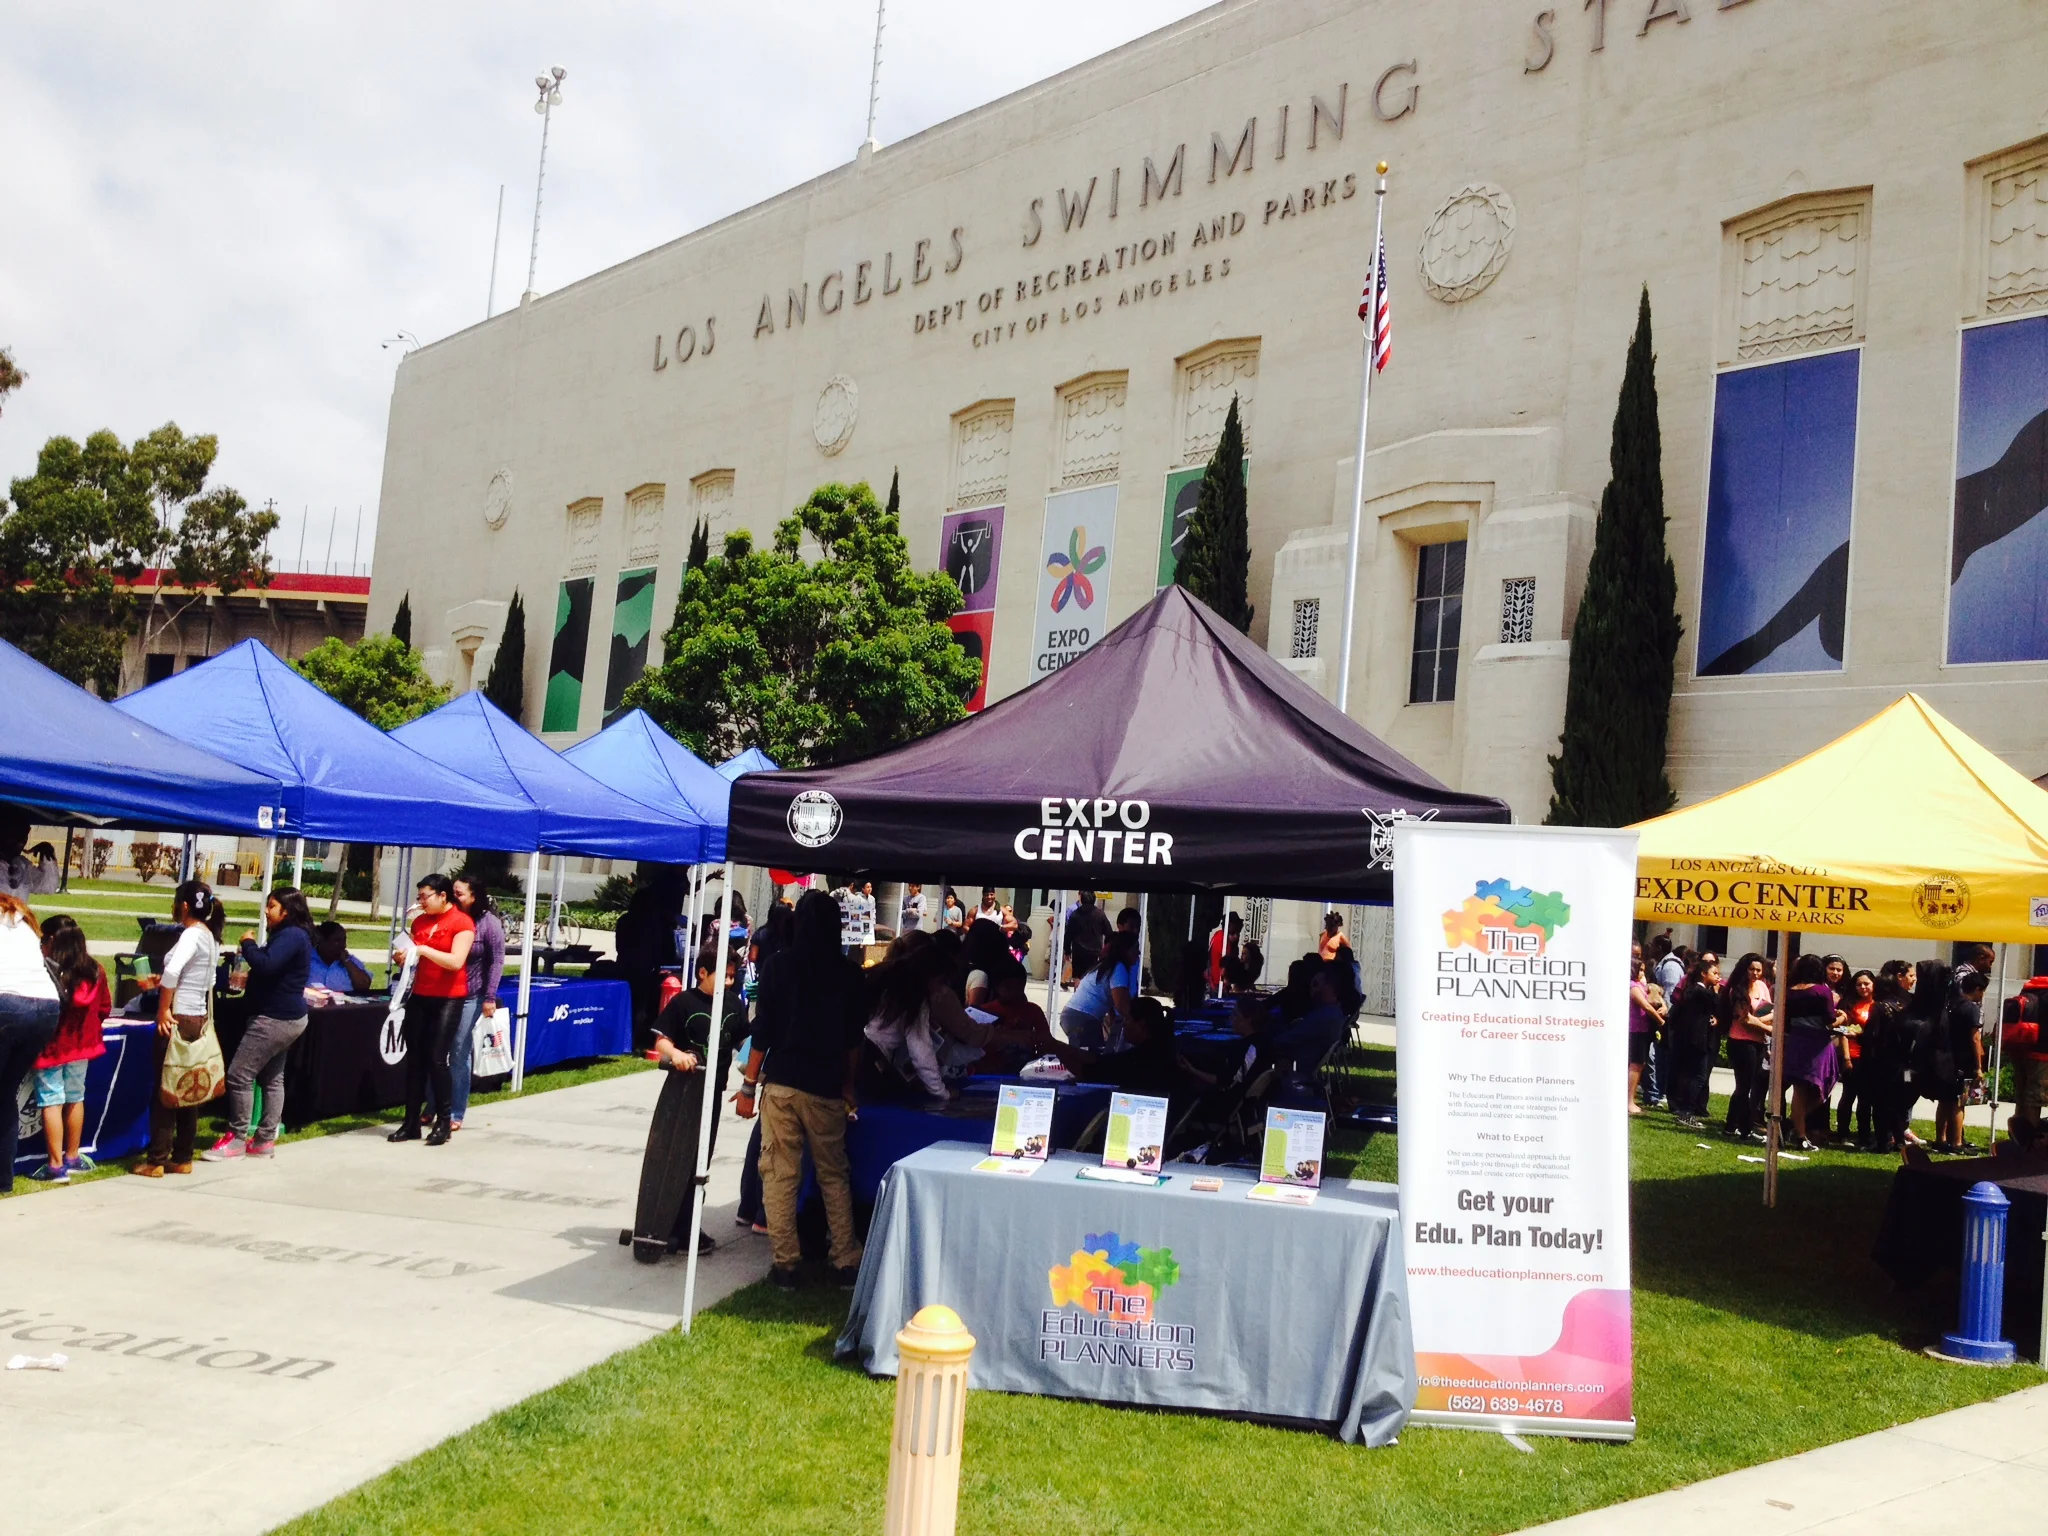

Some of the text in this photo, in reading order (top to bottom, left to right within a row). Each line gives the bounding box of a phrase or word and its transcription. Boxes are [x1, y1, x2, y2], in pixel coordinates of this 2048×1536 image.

[653, 0, 1757, 372] LOS ANGELES SWIMMING STA
[913, 173, 1357, 335] DEPT OF RECREATION AND PARKS
[972, 258, 1232, 350] CITY OF LOS ANGELES
[1048, 627, 1090, 649] EXPO
[1037, 650, 1087, 671] CENT
[1041, 797, 1150, 830] EXPO
[1013, 827, 1174, 866] CENTER
[1671, 858, 1828, 877] LOS ANGELES CITY
[1634, 876, 1871, 912] EXPO CENTER
[1653, 902, 1845, 925] RECREATION & PARKS
[1485, 929, 1537, 951] The
[1437, 951, 1586, 977] Education
[1436, 977, 1586, 1001] PLANNERS
[1421, 1011, 1605, 1030] Creating Educational Strategies
[1460, 1028, 1566, 1042] for Career Success
[1448, 1073, 1575, 1085] Why The Education Planners
[1462, 1091, 1494, 1099] Education
[1496, 1093, 1523, 1101] Planners
[1477, 1132, 1500, 1141] What
[1513, 1134, 1544, 1143] Expect
[1457, 1188, 1554, 1217] Get your
[112, 1219, 504, 1279] Integrity
[1415, 1222, 1604, 1255] Edu. Plan Today!
[1407, 1265, 1604, 1283] www.theeducationplanners.com
[1091, 1287, 1147, 1315] The
[1041, 1308, 1195, 1346] Education
[1040, 1337, 1195, 1372] PLANNERS
[1417, 1375, 1605, 1393] fo@theeducationplanners.com
[1447, 1394, 1564, 1414] (562) 639-4678
